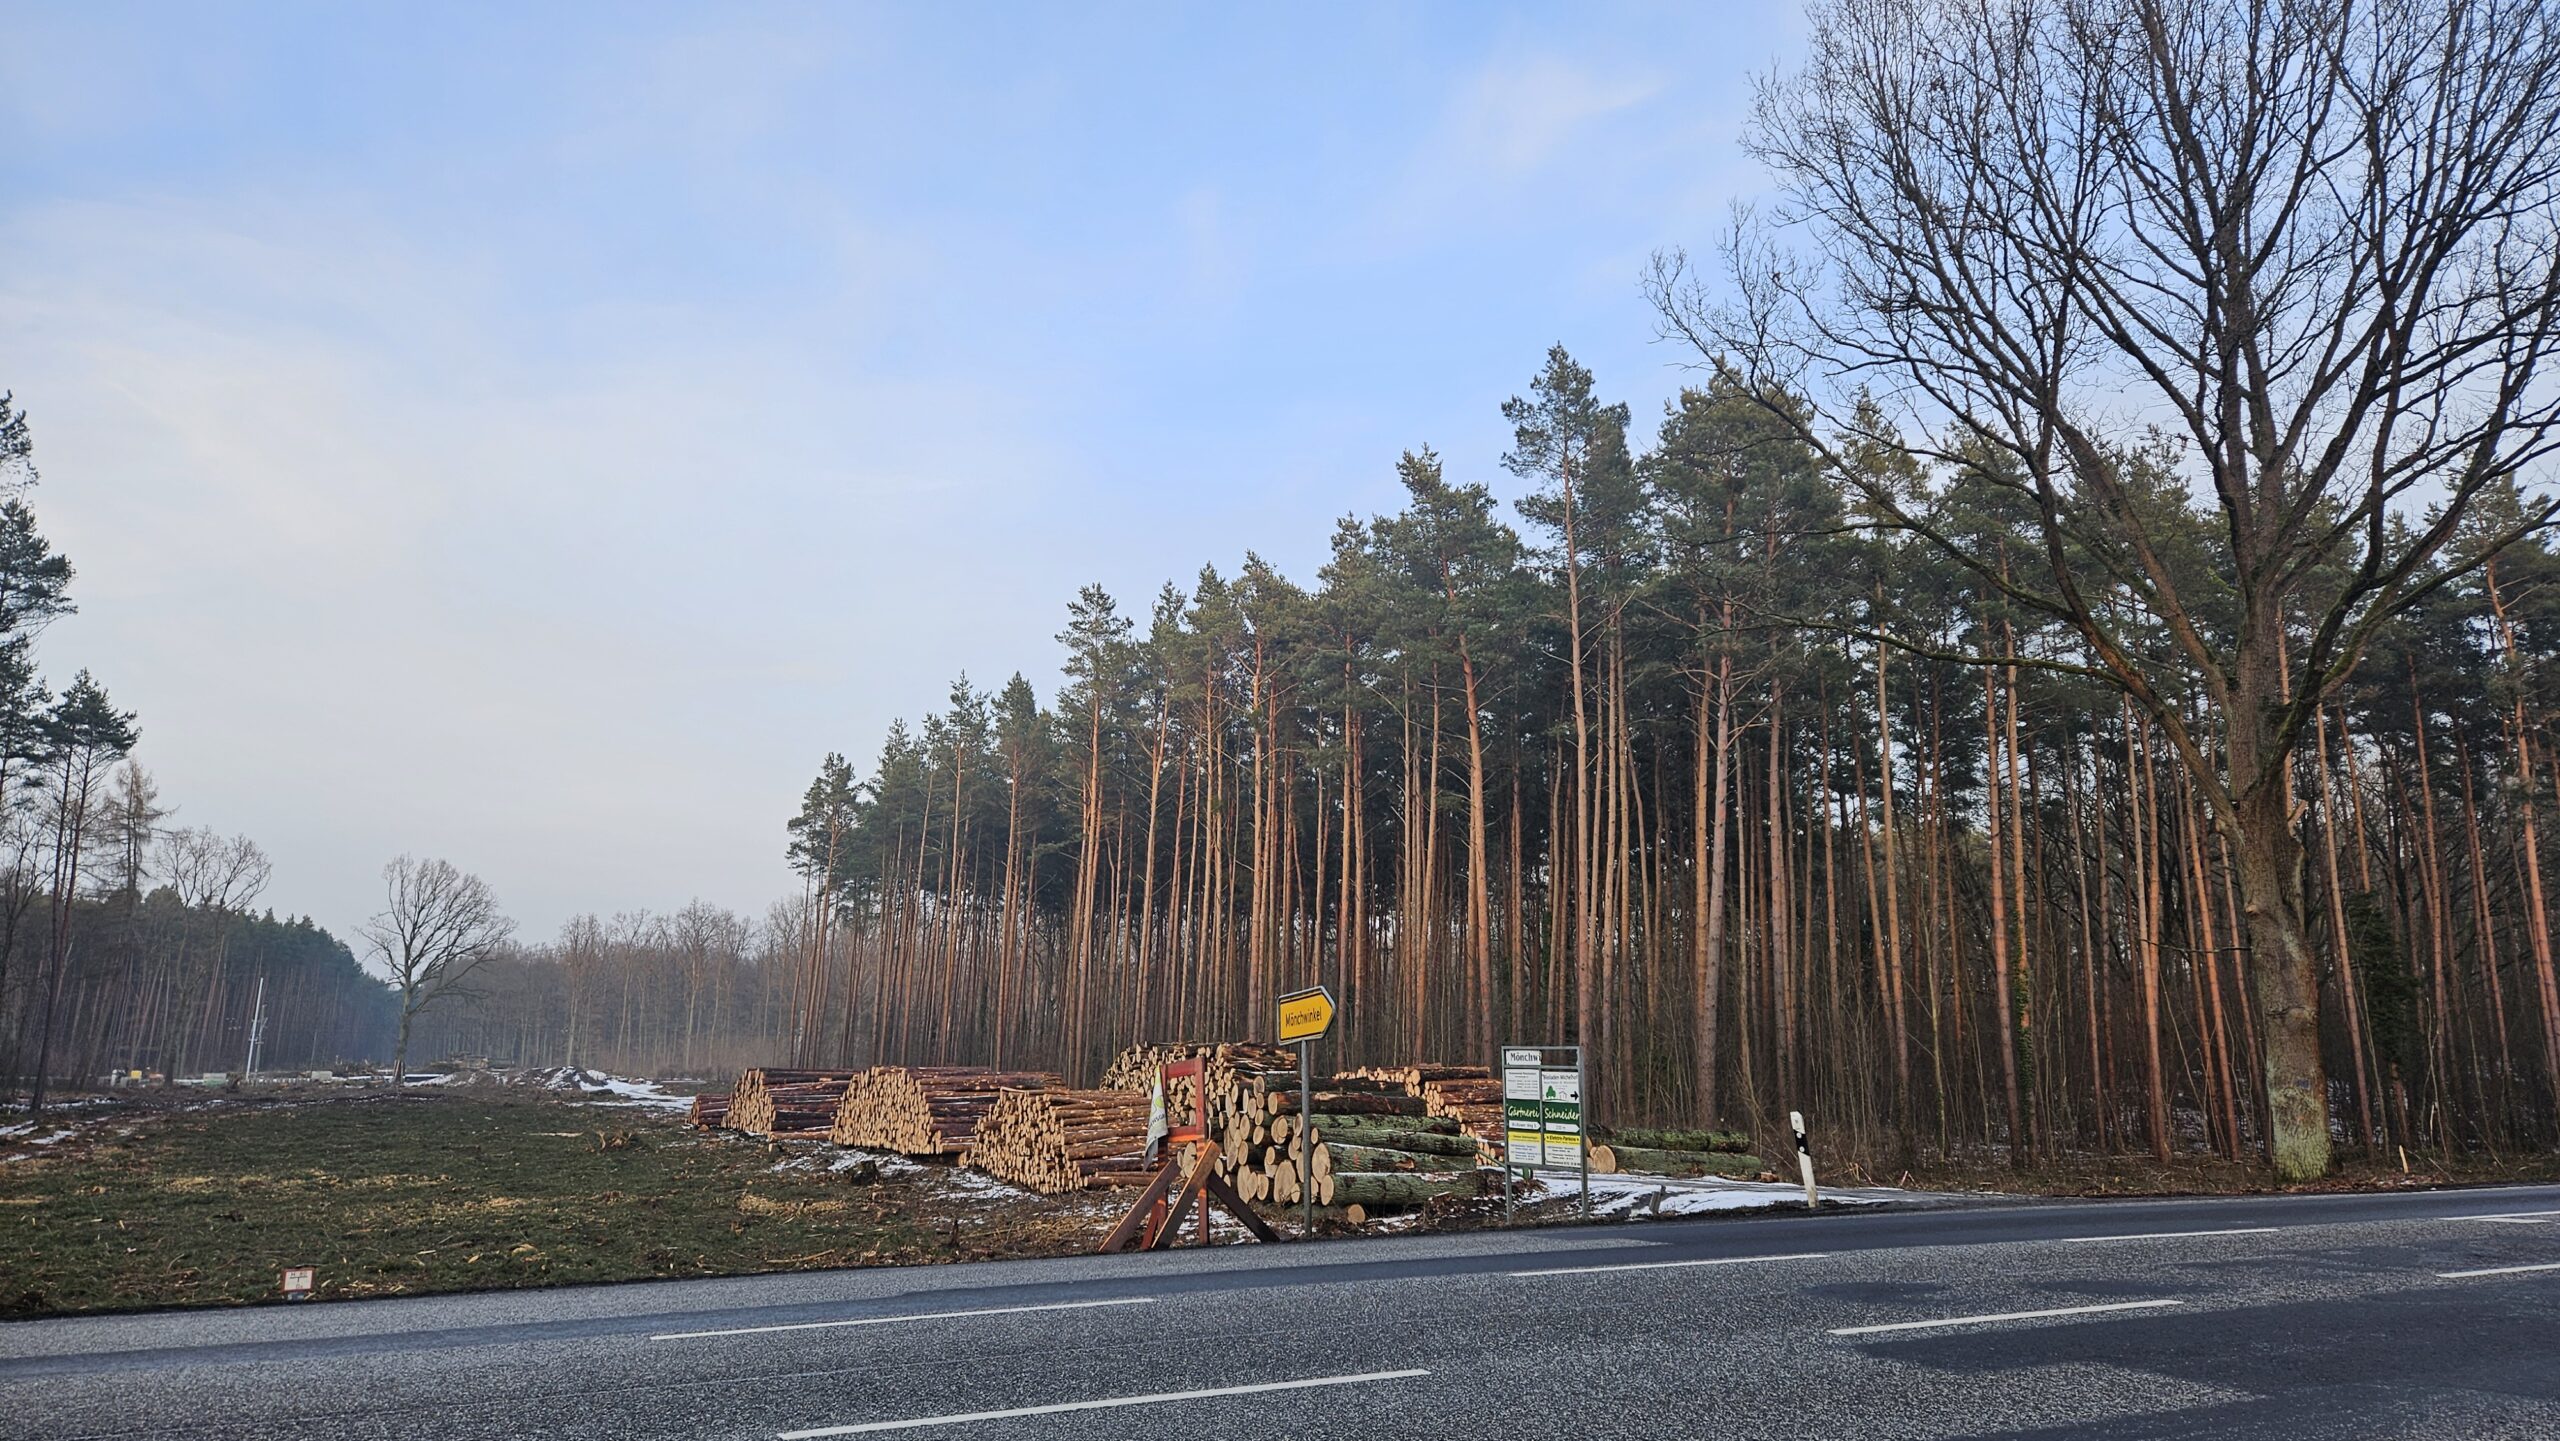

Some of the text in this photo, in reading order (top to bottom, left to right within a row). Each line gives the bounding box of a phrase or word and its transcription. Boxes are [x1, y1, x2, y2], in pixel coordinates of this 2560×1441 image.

[1285, 1006, 1323, 1028] Mönchwinkel
[1507, 1106, 1581, 1120] Gärtnerei Schneider
